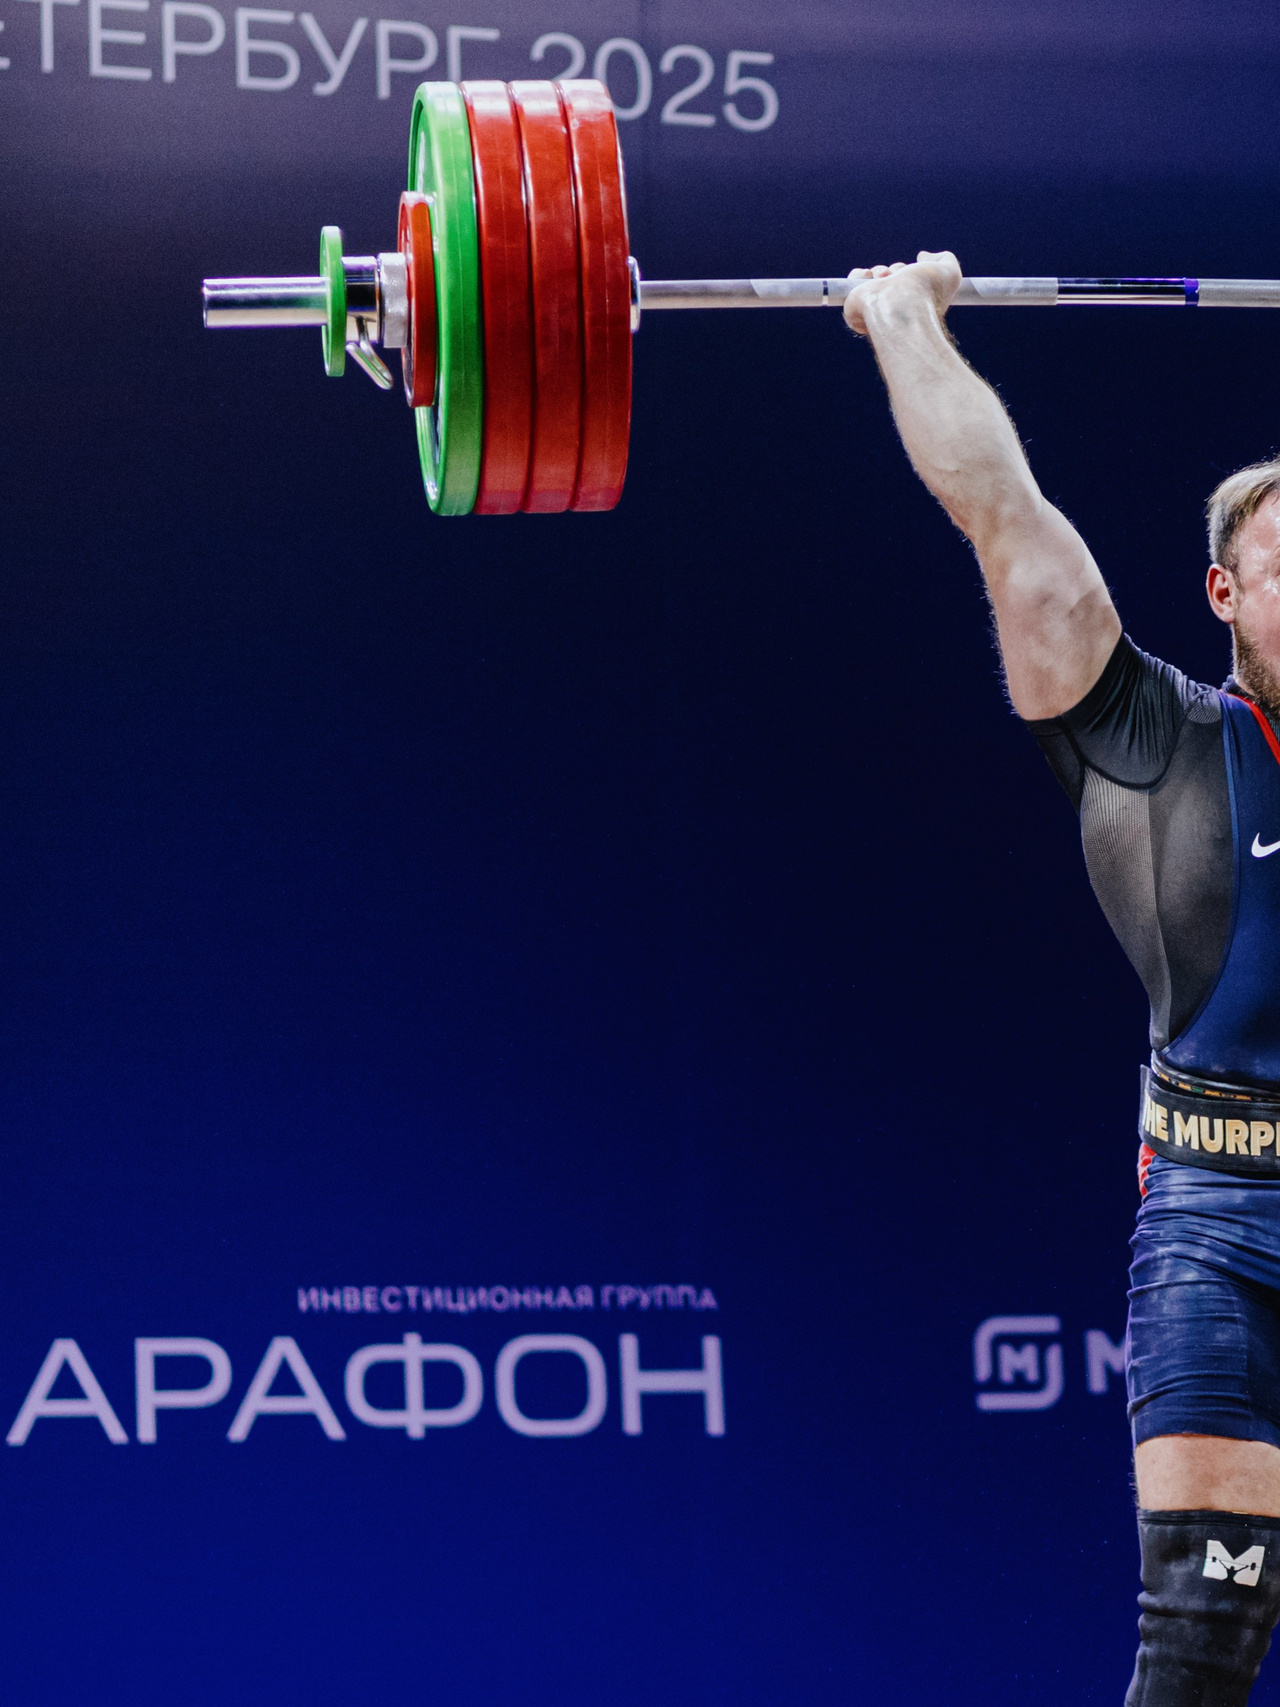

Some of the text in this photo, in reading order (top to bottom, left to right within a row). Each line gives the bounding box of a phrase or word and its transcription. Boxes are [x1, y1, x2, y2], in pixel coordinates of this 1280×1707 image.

[0, 0, 780, 132] ТЕРБУРГ 2025
[297, 1284, 718, 1315] ИНВЕСТИЦИОННАЯ ГРУППА
[6, 1331, 726, 1446] АРАФОН
